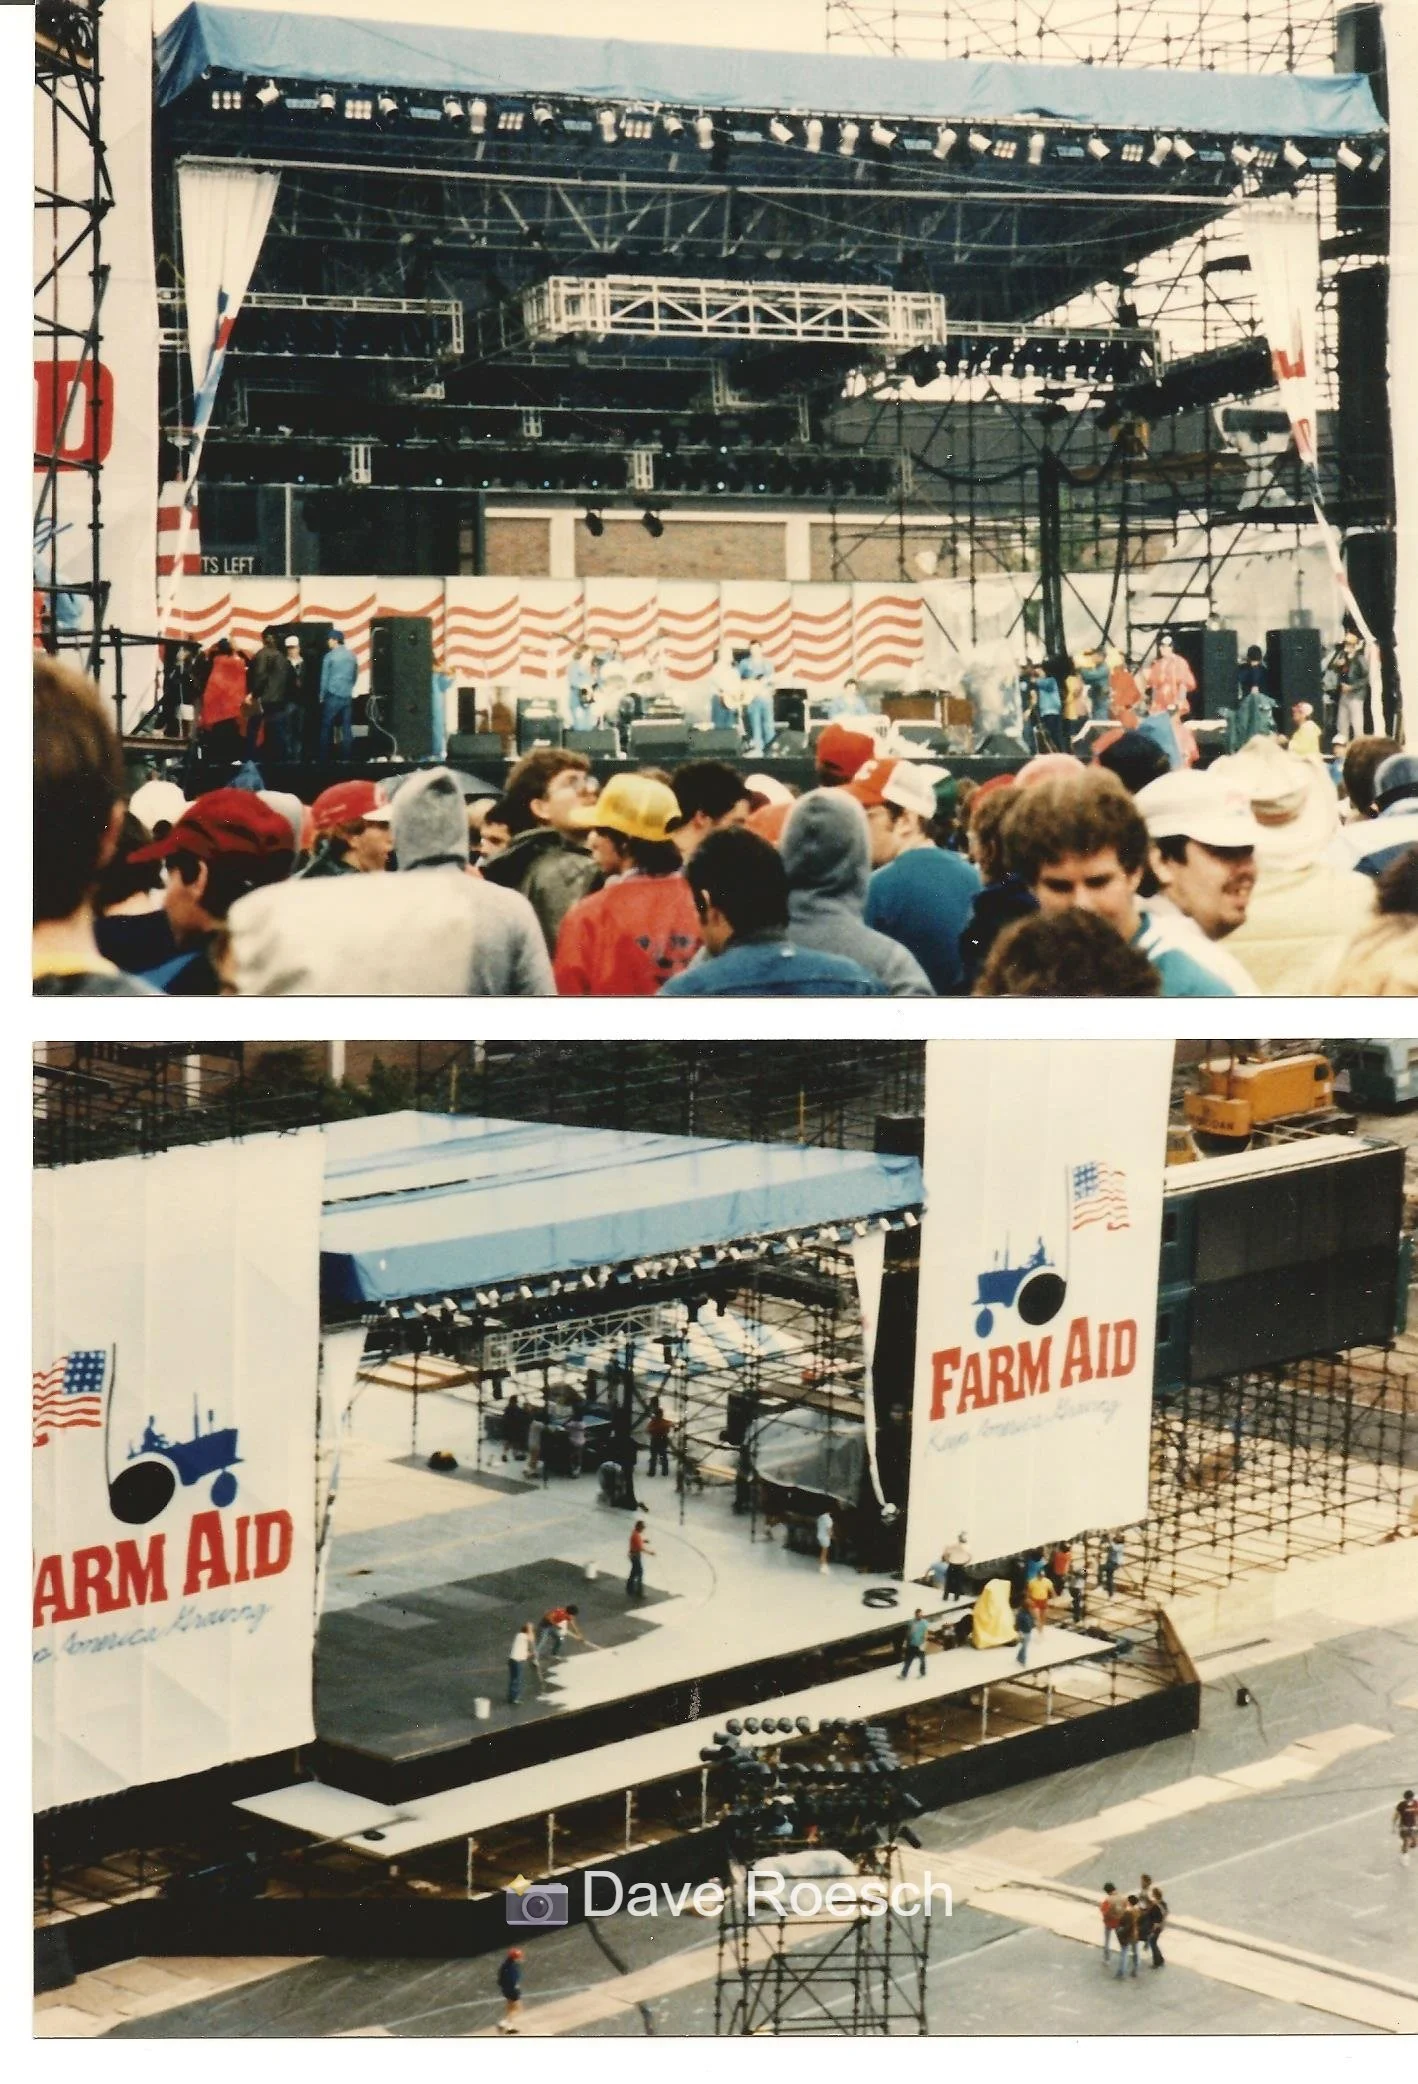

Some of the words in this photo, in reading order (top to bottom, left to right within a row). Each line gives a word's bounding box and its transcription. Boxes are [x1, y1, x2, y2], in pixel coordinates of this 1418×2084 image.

[223, 556, 255, 575] LEFT
[929, 1334, 1054, 1422] FARM
[1059, 1316, 1138, 1389] AID
[33, 1532, 168, 1628] ARM
[182, 1507, 294, 1596] AID
